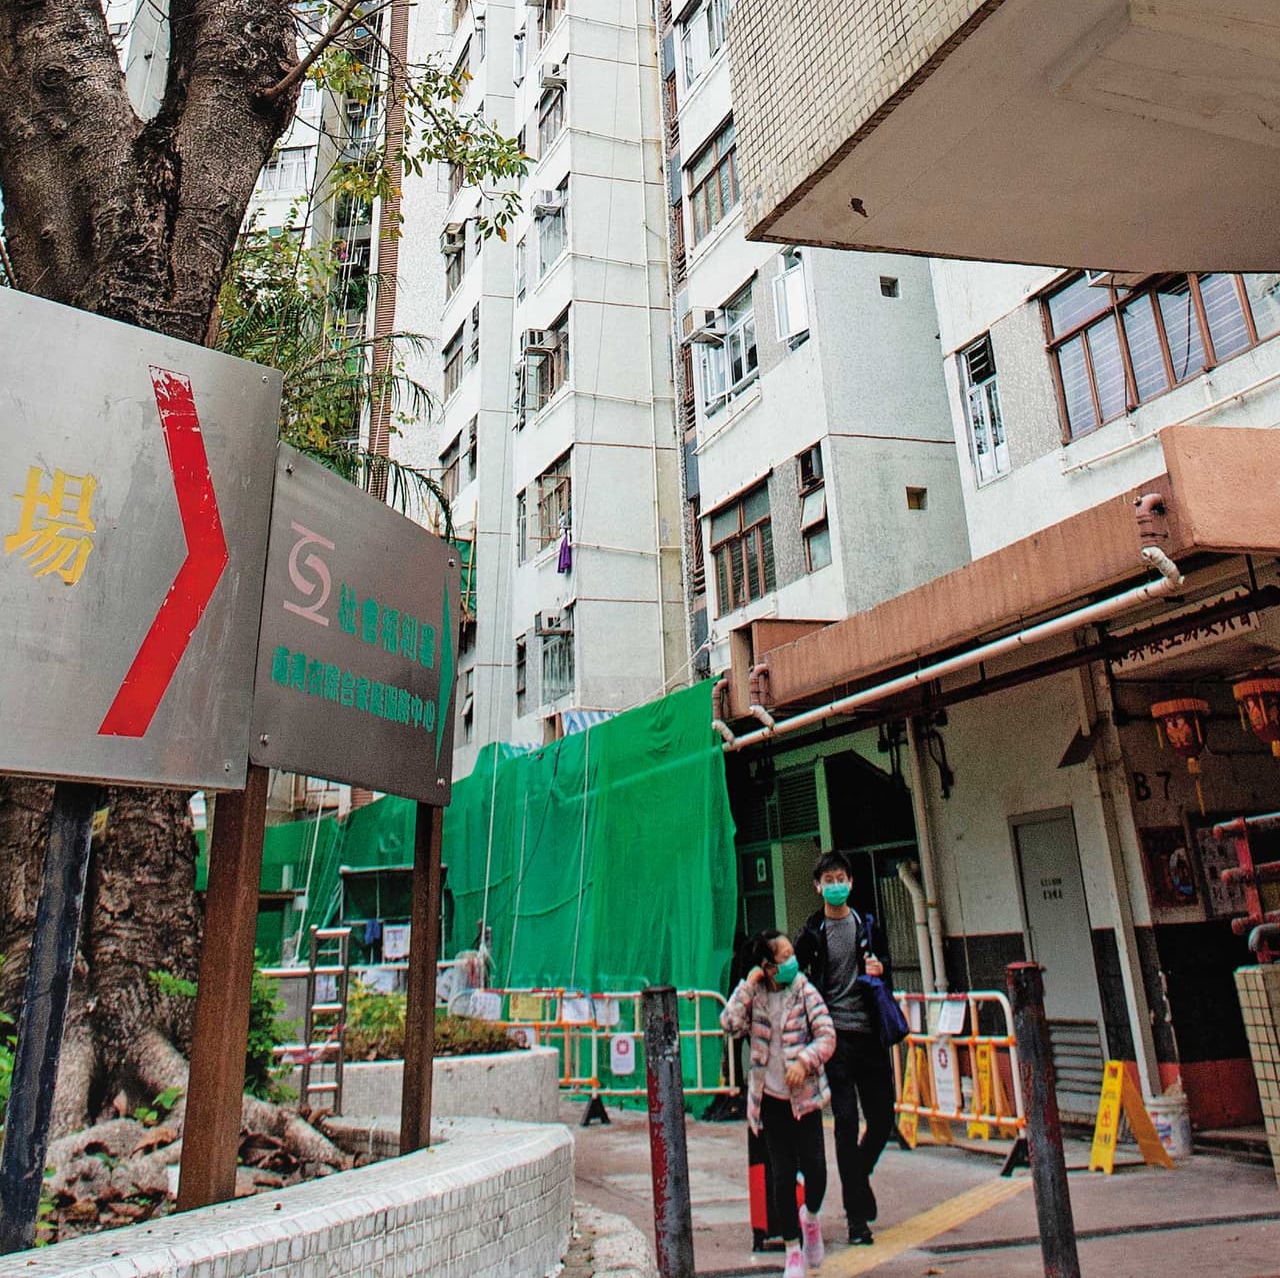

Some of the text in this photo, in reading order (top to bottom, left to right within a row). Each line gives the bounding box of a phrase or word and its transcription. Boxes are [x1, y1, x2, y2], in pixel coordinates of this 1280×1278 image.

[337, 582, 436, 669] 社會福利署
